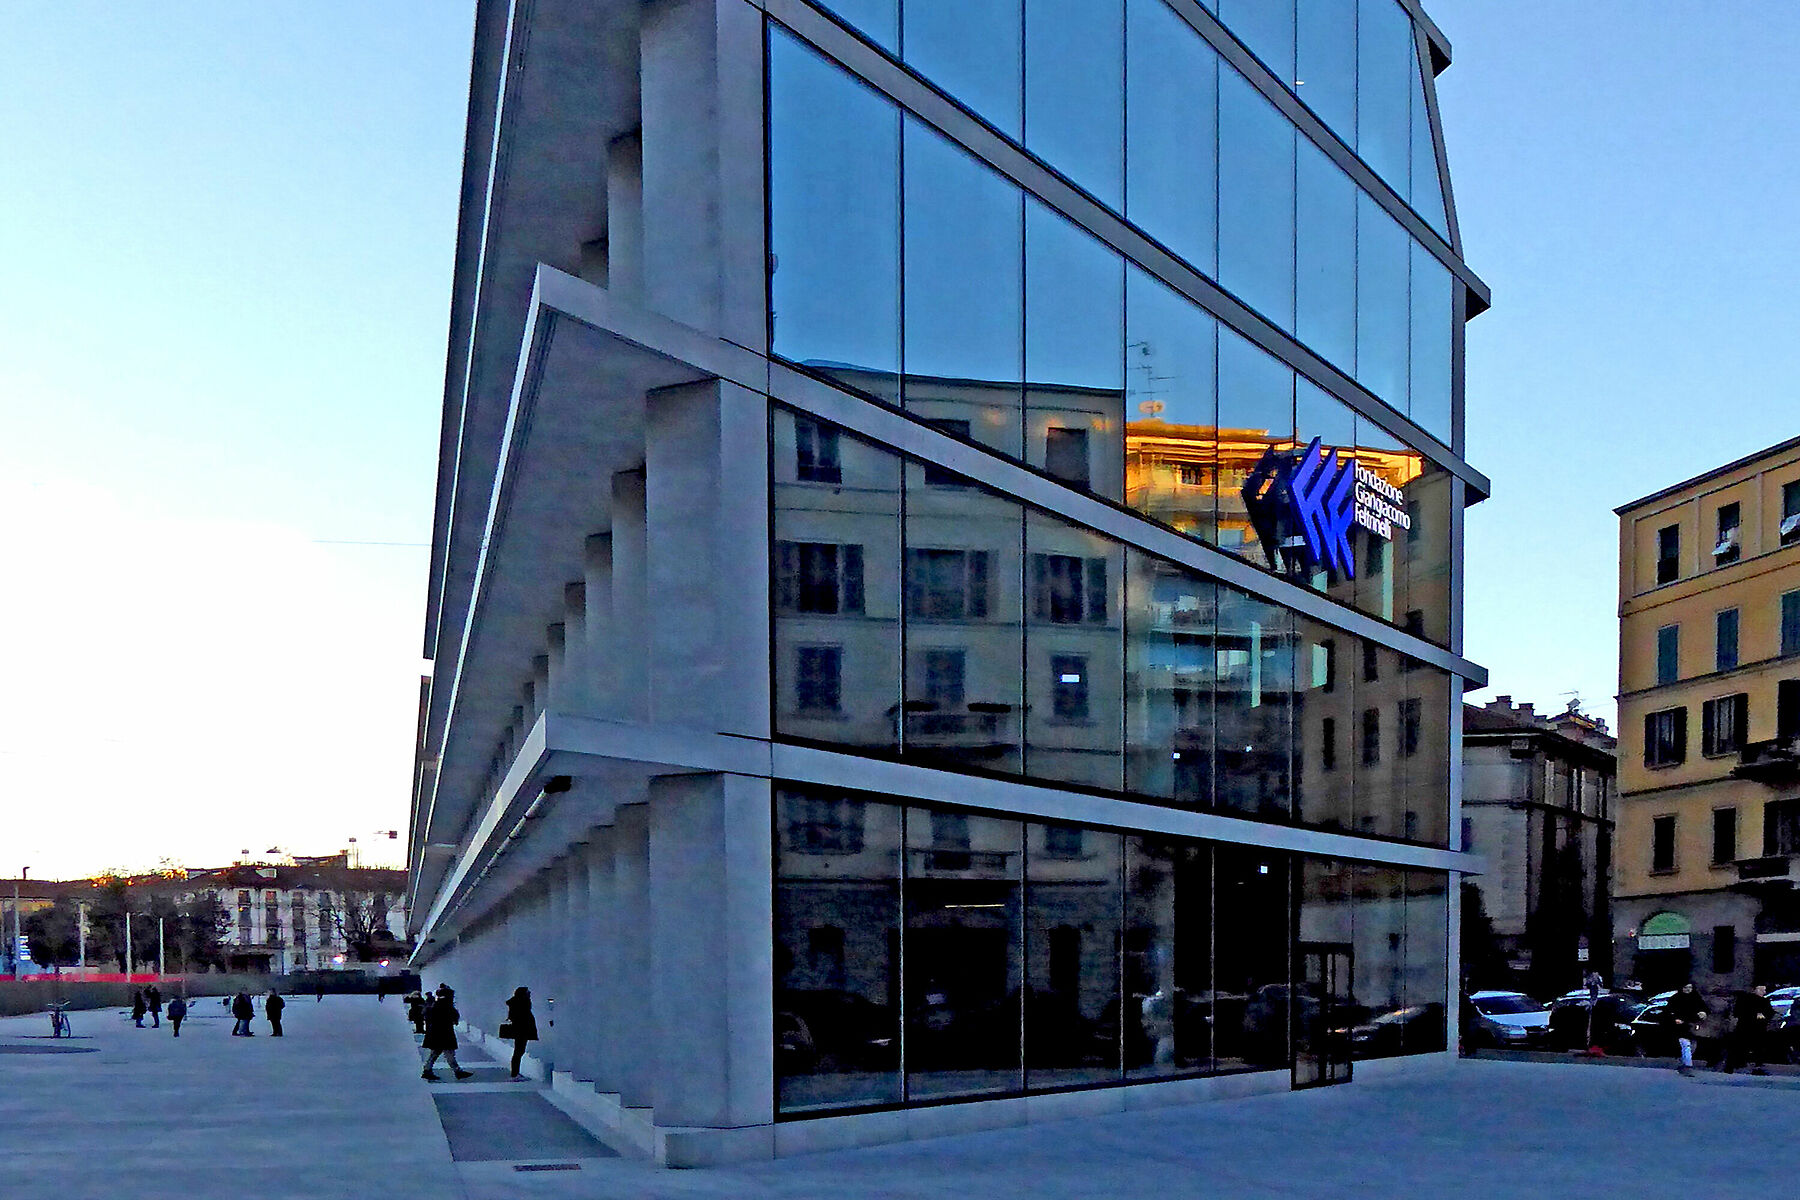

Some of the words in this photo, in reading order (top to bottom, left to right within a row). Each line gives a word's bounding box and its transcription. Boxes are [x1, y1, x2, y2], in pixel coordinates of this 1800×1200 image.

[1355, 459, 1404, 506] Fondazione
[1355, 482, 1411, 530] Giangiacomo
[1355, 502, 1392, 540] Feltrinelli
